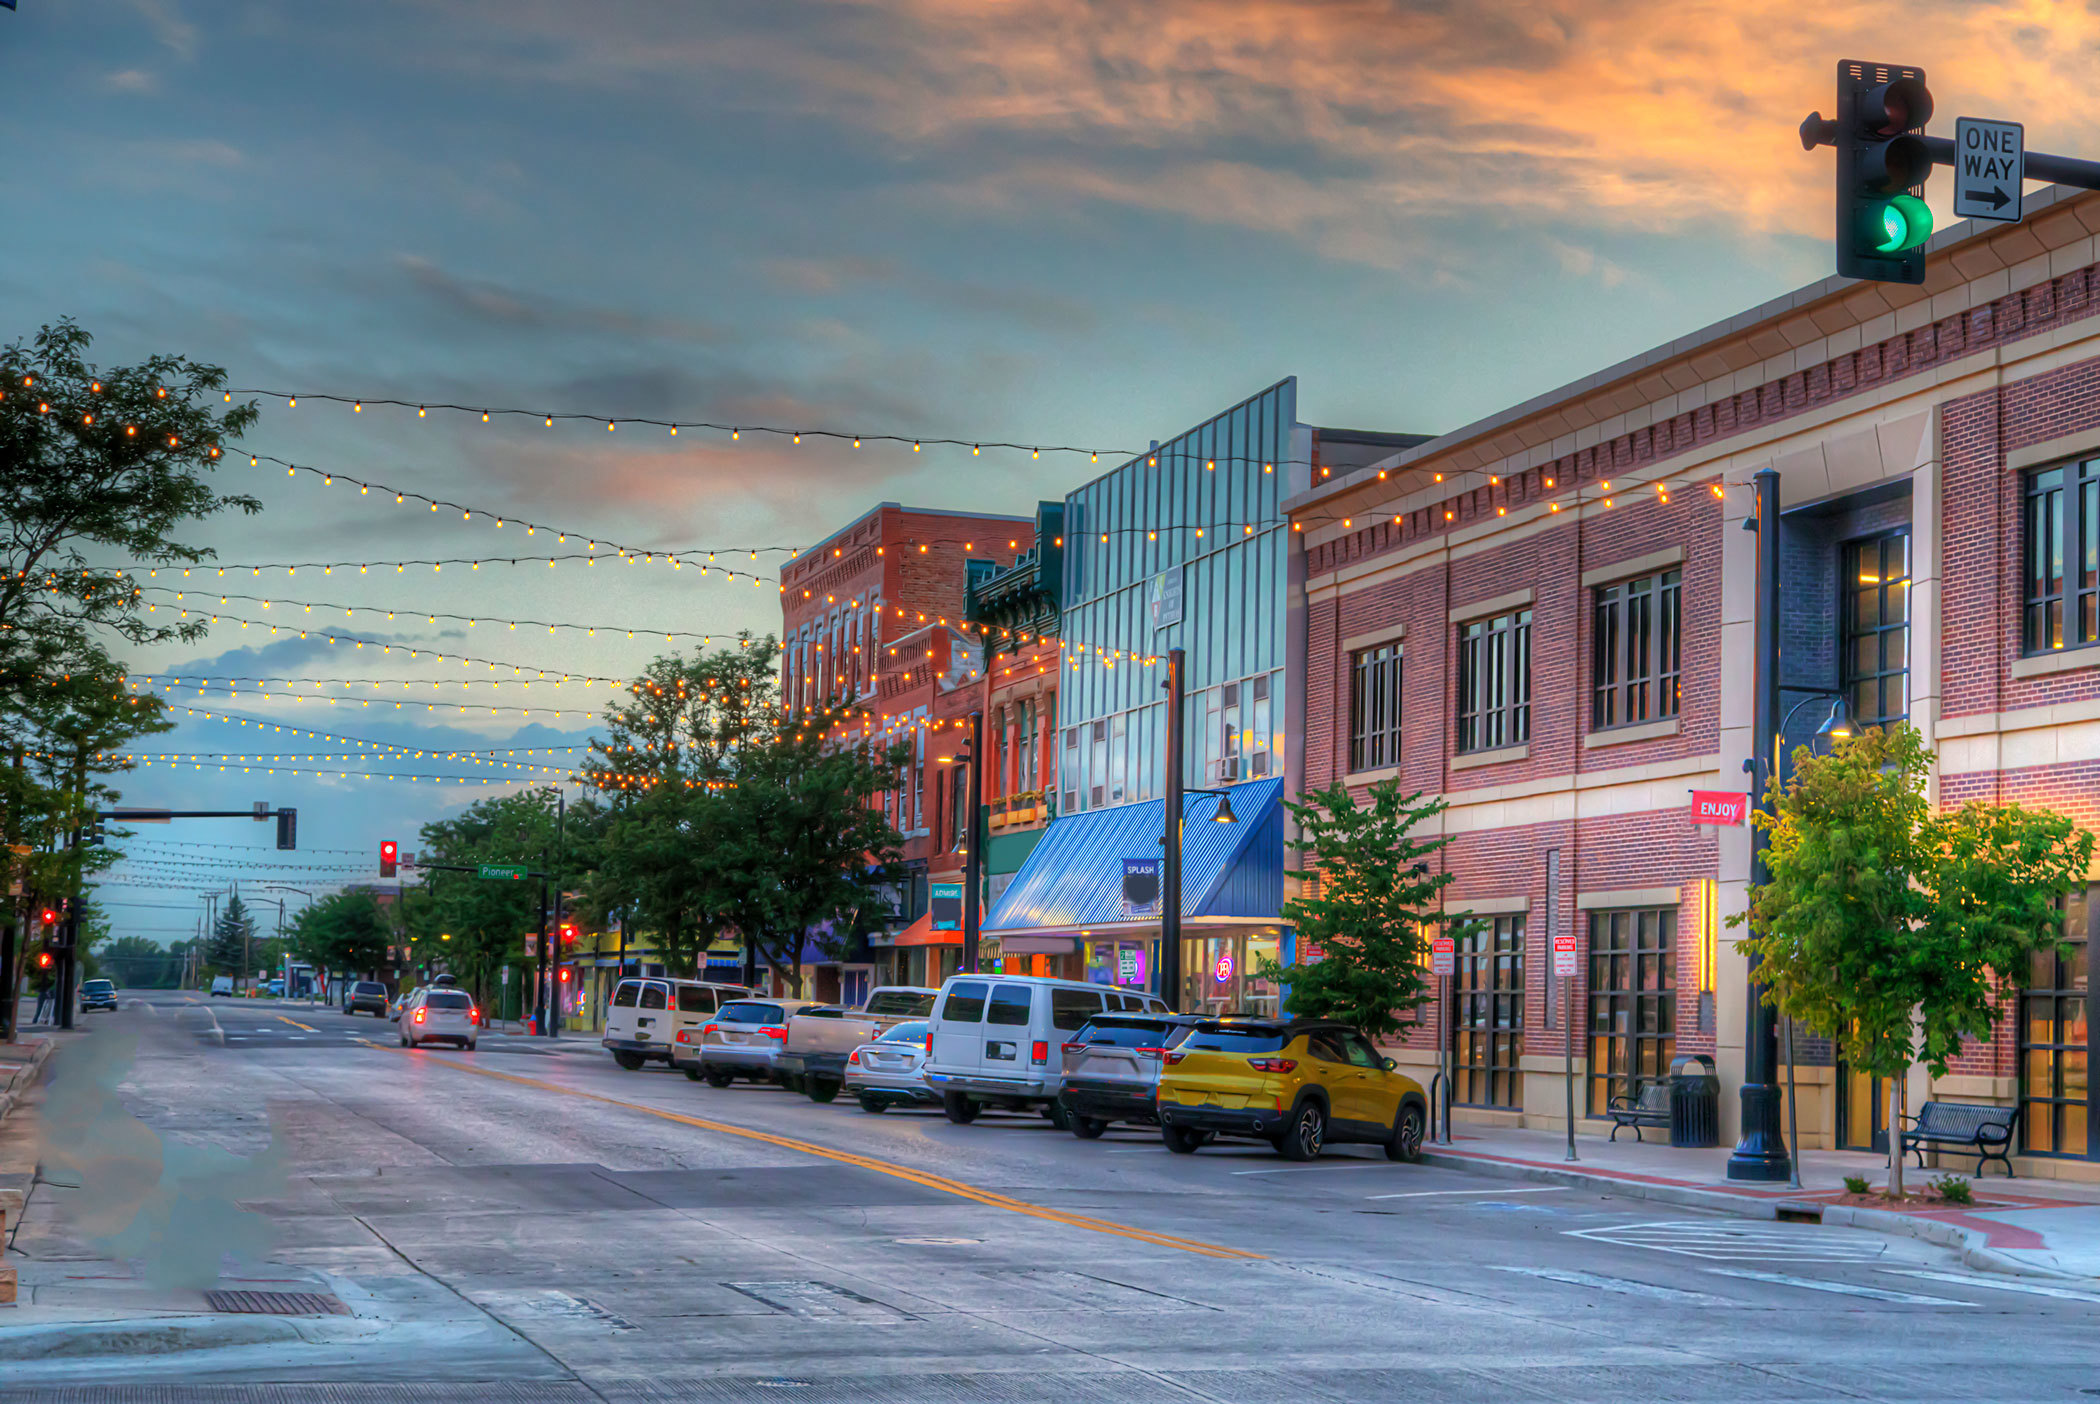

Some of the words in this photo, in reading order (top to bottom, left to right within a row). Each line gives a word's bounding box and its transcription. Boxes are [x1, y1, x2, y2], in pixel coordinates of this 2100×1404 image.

[1966, 127, 2014, 154] ONE
[1964, 154, 2014, 181] WAY
[1701, 802, 1737, 817] ENJOY
[482, 866, 514, 877] Pioneer
[1127, 865, 1155, 874] SPLASH
